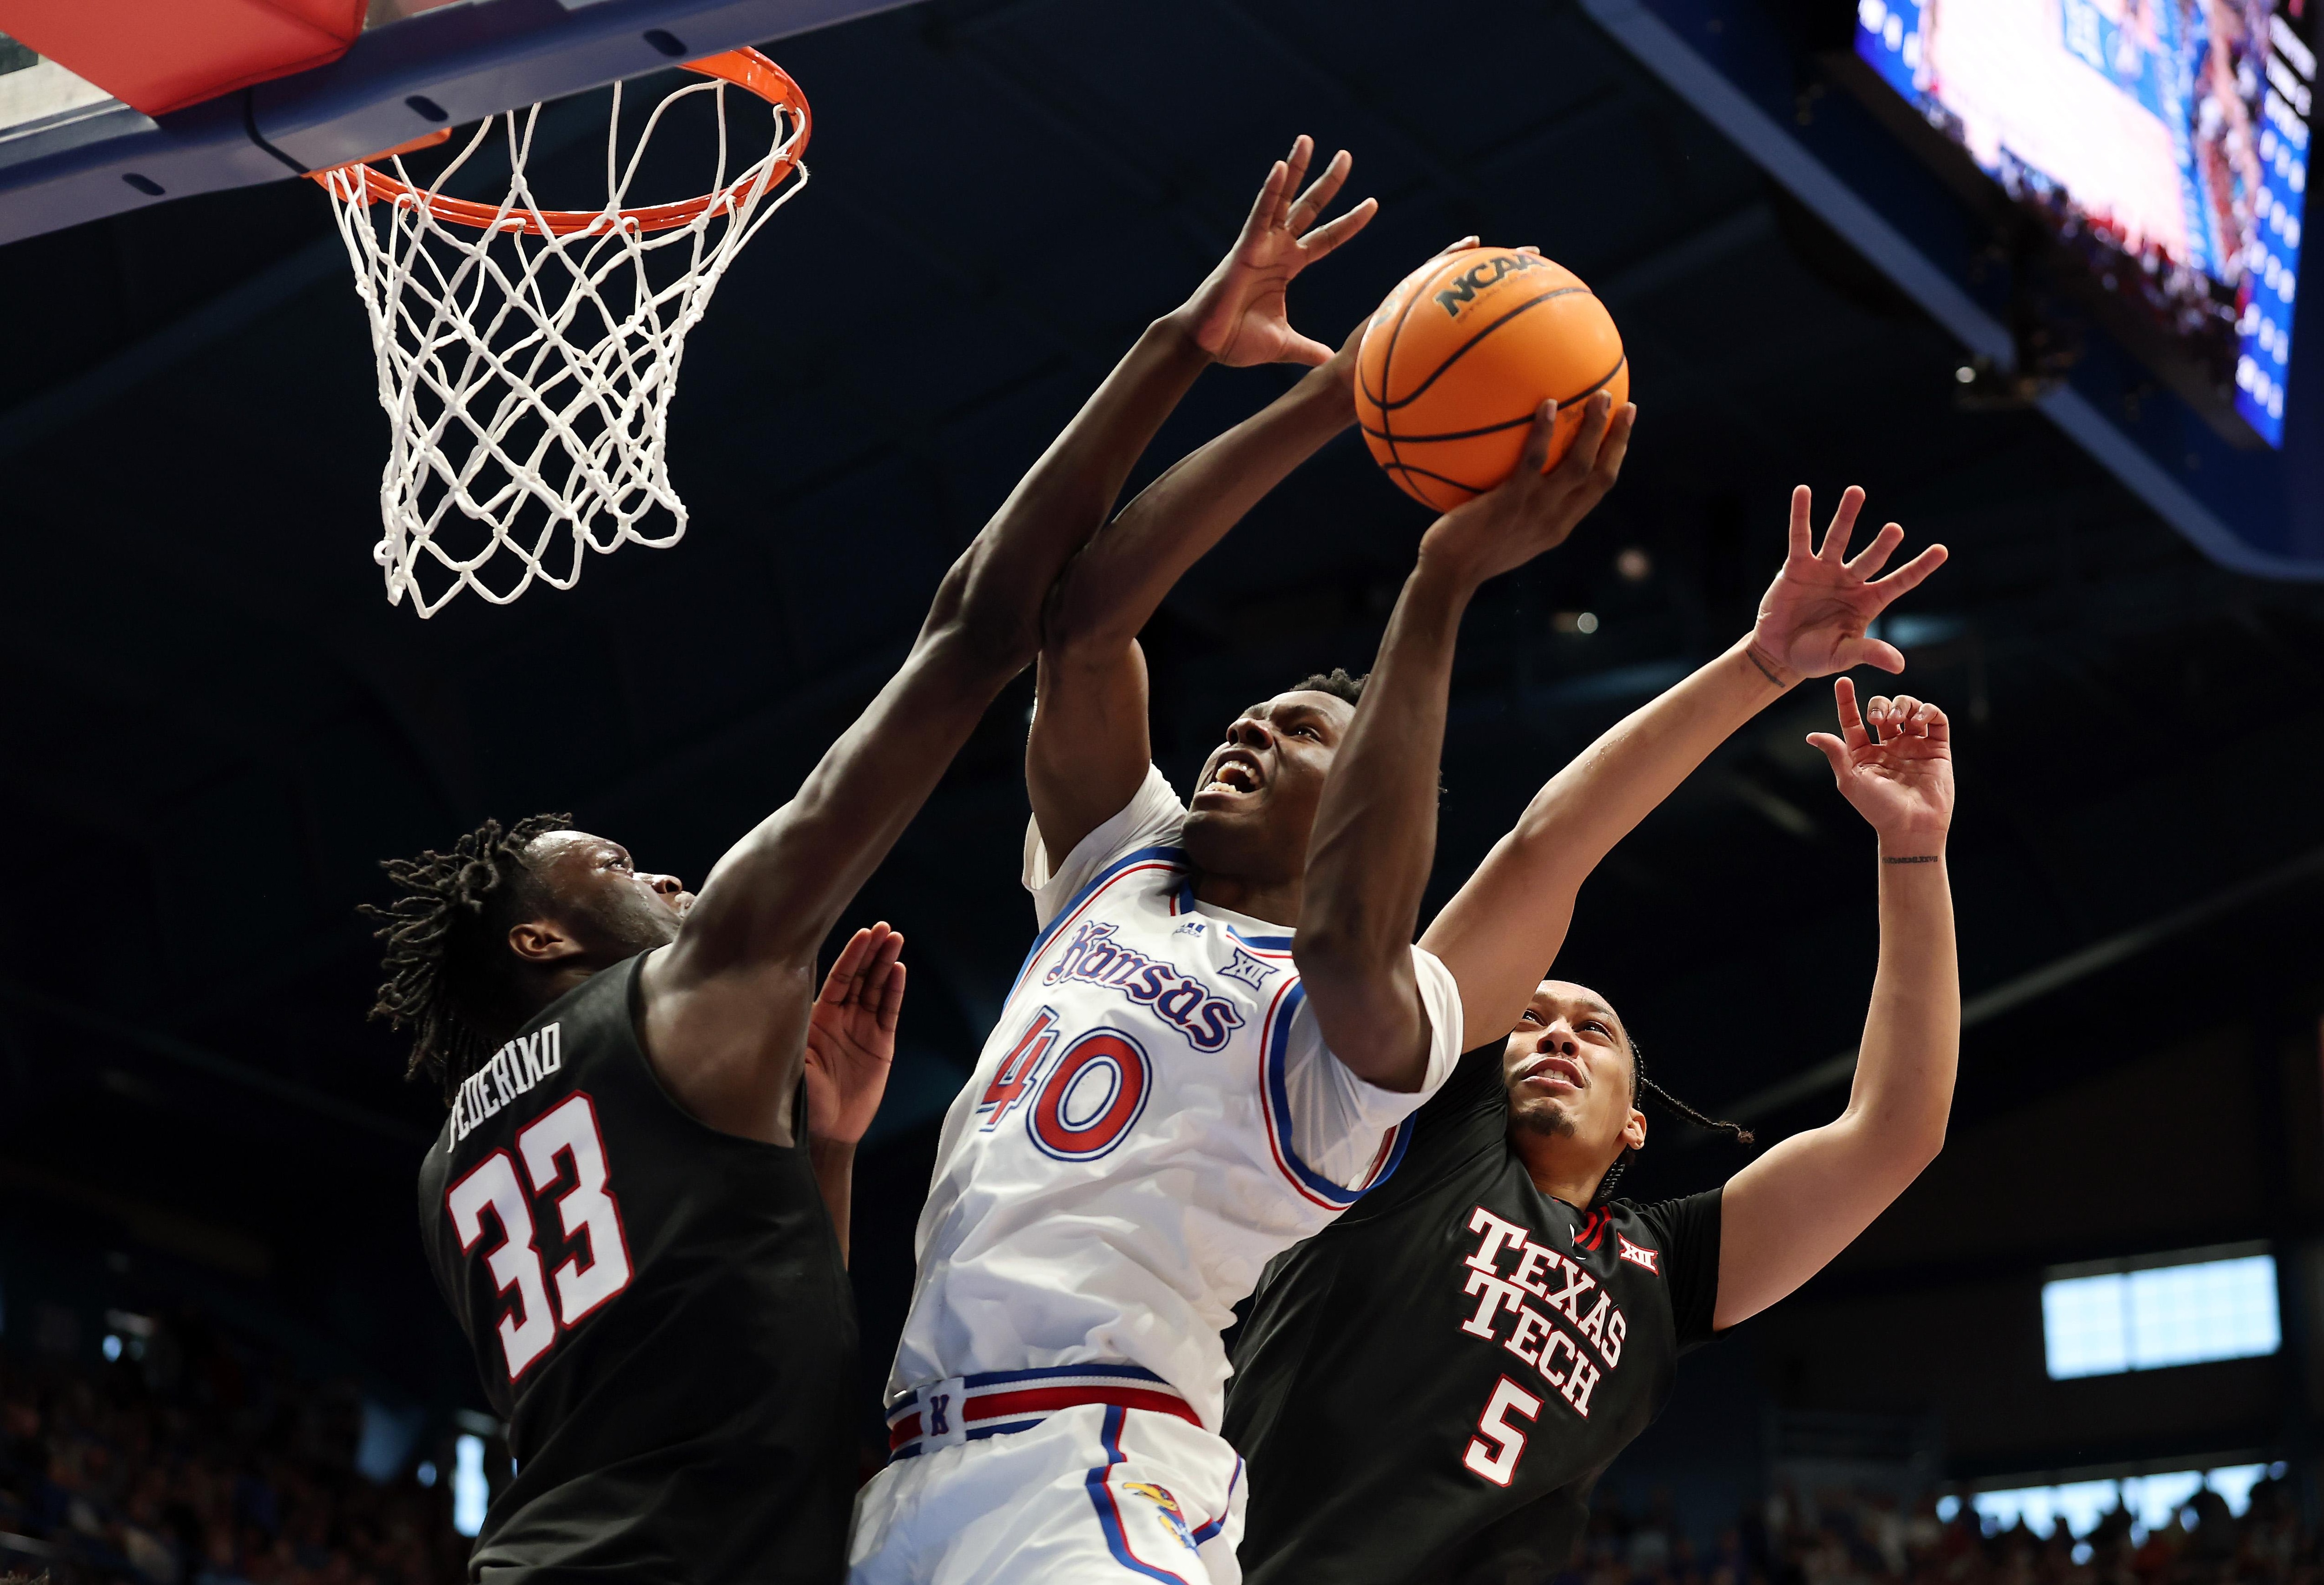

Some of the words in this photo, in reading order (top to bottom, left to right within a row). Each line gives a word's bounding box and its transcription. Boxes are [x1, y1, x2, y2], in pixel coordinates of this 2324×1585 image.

[1435, 255, 1547, 317] NCAA
[1043, 920, 1245, 1053] Kansas
[1216, 947, 1280, 991] XII
[976, 1005, 1152, 1162] 40
[445, 1089, 634, 1384] 33
[1463, 1206, 1626, 1369] TEXAS
[1618, 1232, 1659, 1276] XII
[1460, 1269, 1601, 1419] TECH
[931, 1394, 950, 1437] K
[1463, 1373, 1545, 1488] 5
